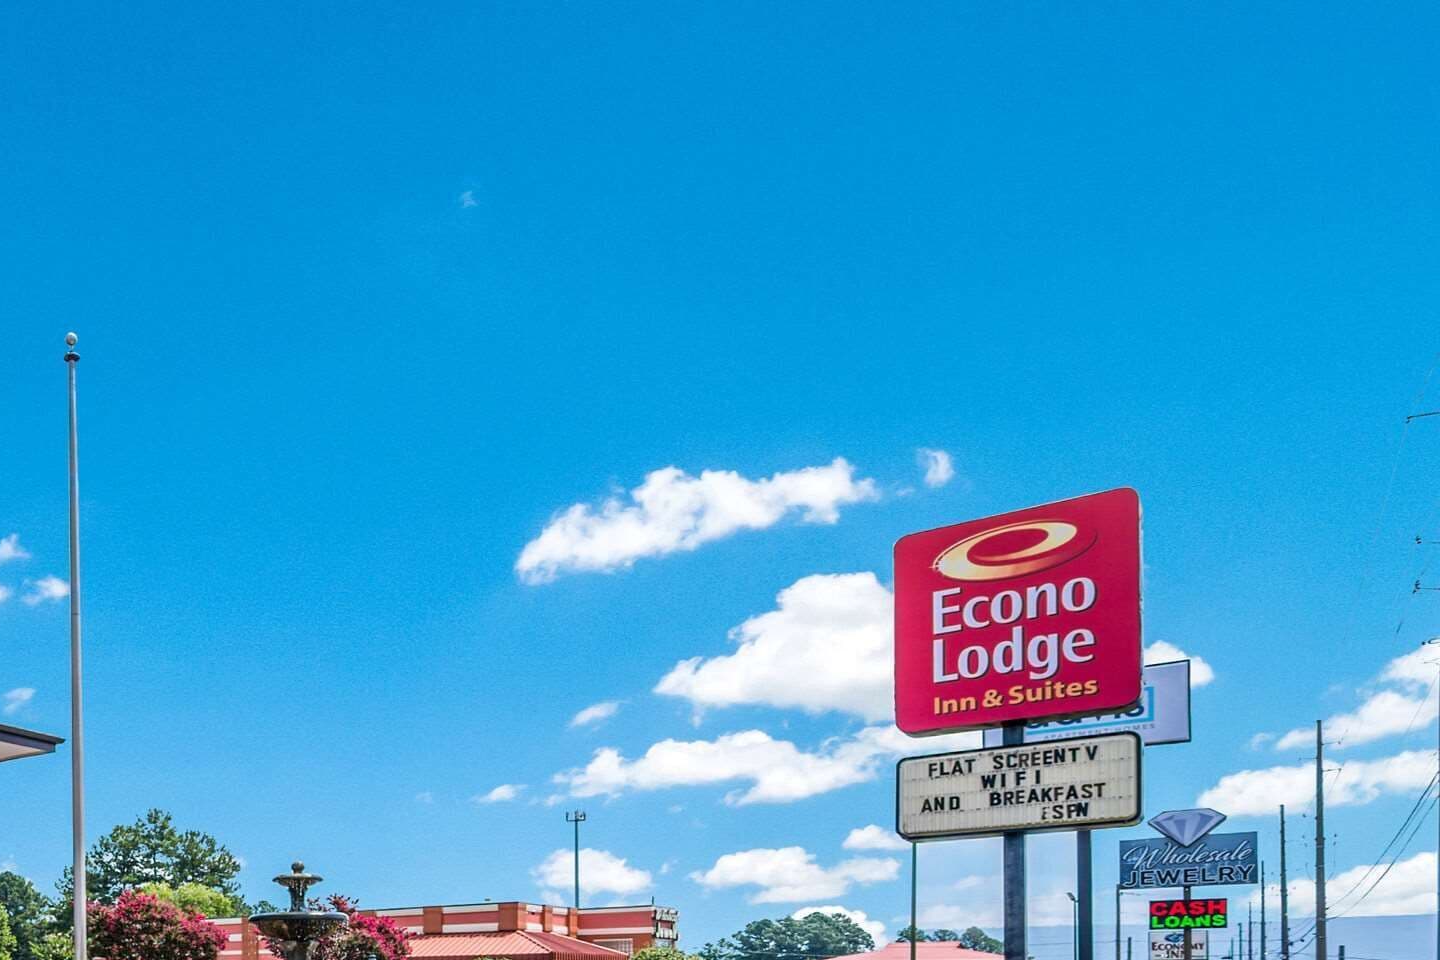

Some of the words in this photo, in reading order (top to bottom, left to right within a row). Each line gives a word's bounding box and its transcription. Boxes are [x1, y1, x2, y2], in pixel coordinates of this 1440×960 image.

[933, 577, 1096, 635] Econo
[933, 625, 1095, 683] Lodge
[934, 697, 976, 714] Inn
[982, 689, 1003, 707] &
[1008, 680, 1098, 704] Suites
[928, 758, 976, 778] FLAT
[921, 796, 960, 813] AND
[989, 782, 1106, 807] BREAKFAST
[1123, 840, 1253, 869] Wholesale
[1124, 864, 1255, 887] JEWELRY
[1151, 900, 1226, 915] CASH
[1152, 914, 1226, 928] LOANS
